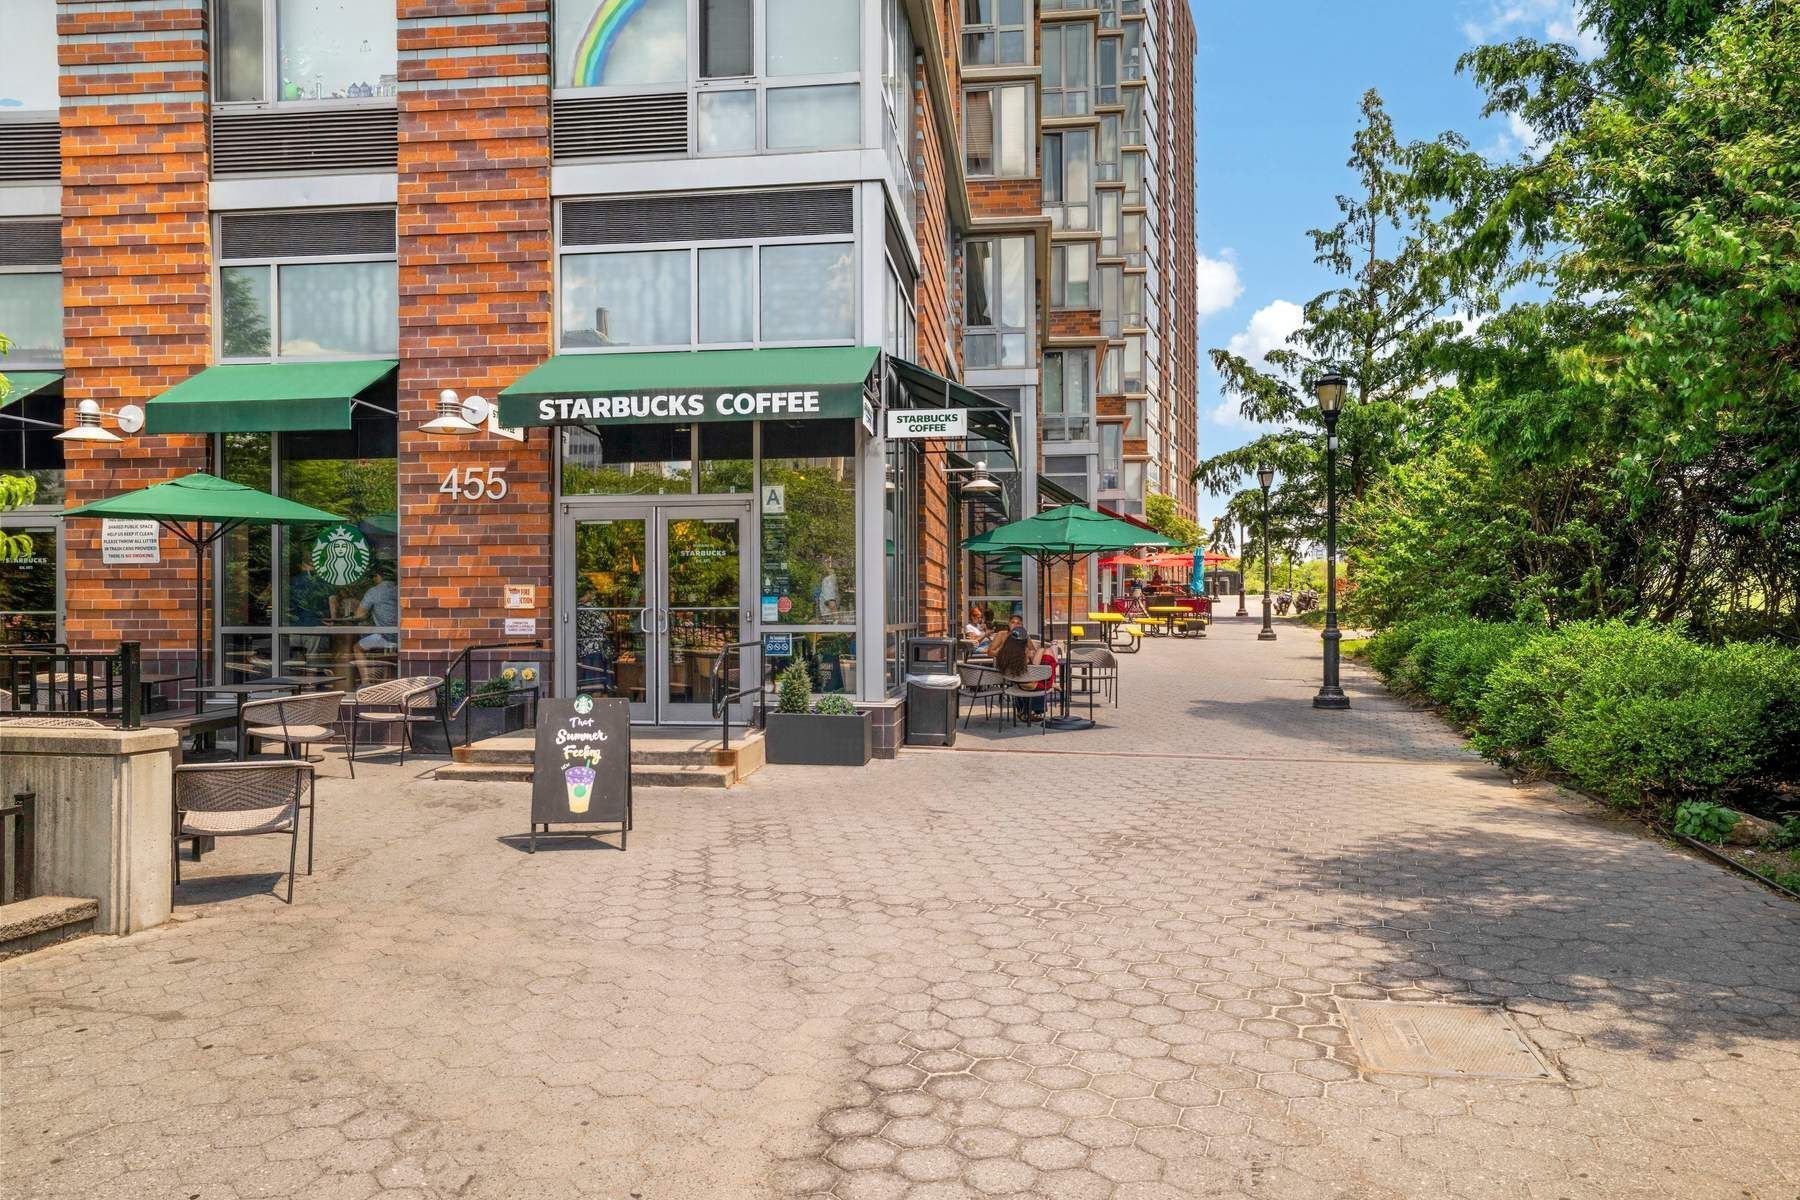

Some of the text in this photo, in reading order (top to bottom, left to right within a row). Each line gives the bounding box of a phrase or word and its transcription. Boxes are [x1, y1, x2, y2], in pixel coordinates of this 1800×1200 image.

[539, 391, 820, 420] STARBUCKS COFFEE
[896, 413, 958, 424] STARBUCKS
[908, 423, 946, 433] COFFEE
[439, 467, 507, 500] 455
[766, 489, 780, 506] A
[569, 716, 595, 728] That
[555, 728, 608, 745] Summer
[562, 744, 602, 765] Feeling
